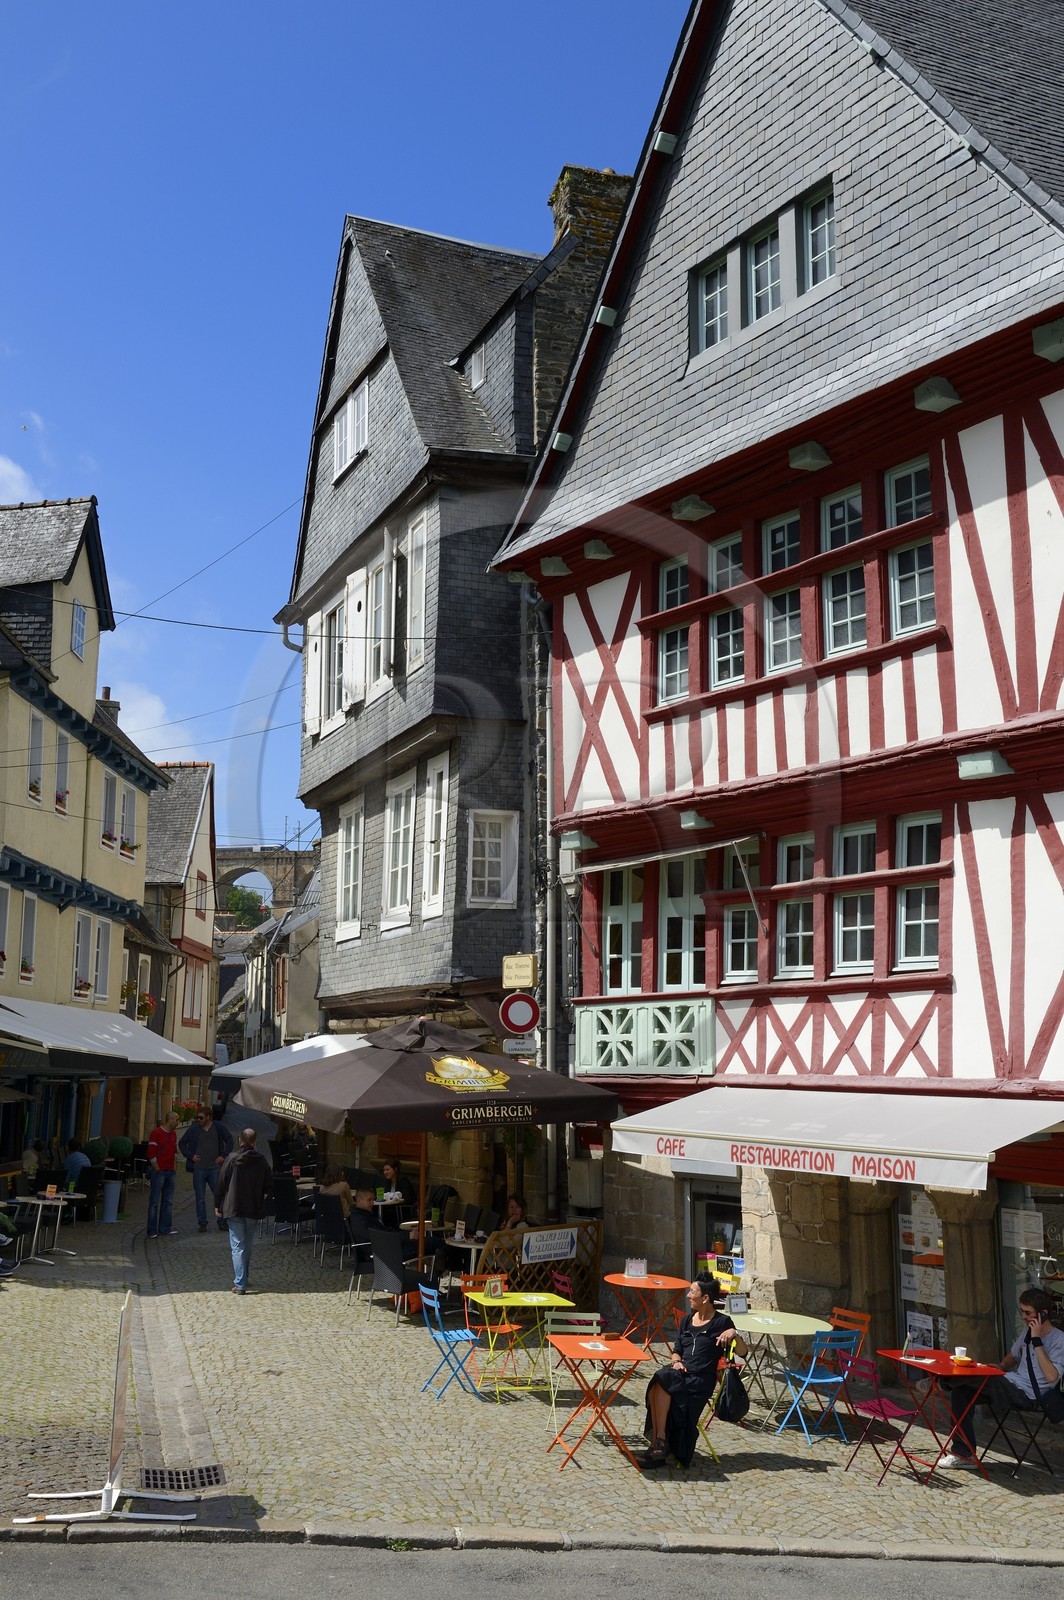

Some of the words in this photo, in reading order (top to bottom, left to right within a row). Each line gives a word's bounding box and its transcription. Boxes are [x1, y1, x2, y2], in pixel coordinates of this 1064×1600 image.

[433, 1074, 506, 1087] GRIMBERGEN
[272, 1095, 305, 1114] GRIMBERGEN
[451, 1105, 533, 1120] GRIMBERGEN
[656, 1136, 686, 1157] CAFE
[730, 1143, 835, 1173] RESTAURATION
[852, 1154, 916, 1181] MAISON
